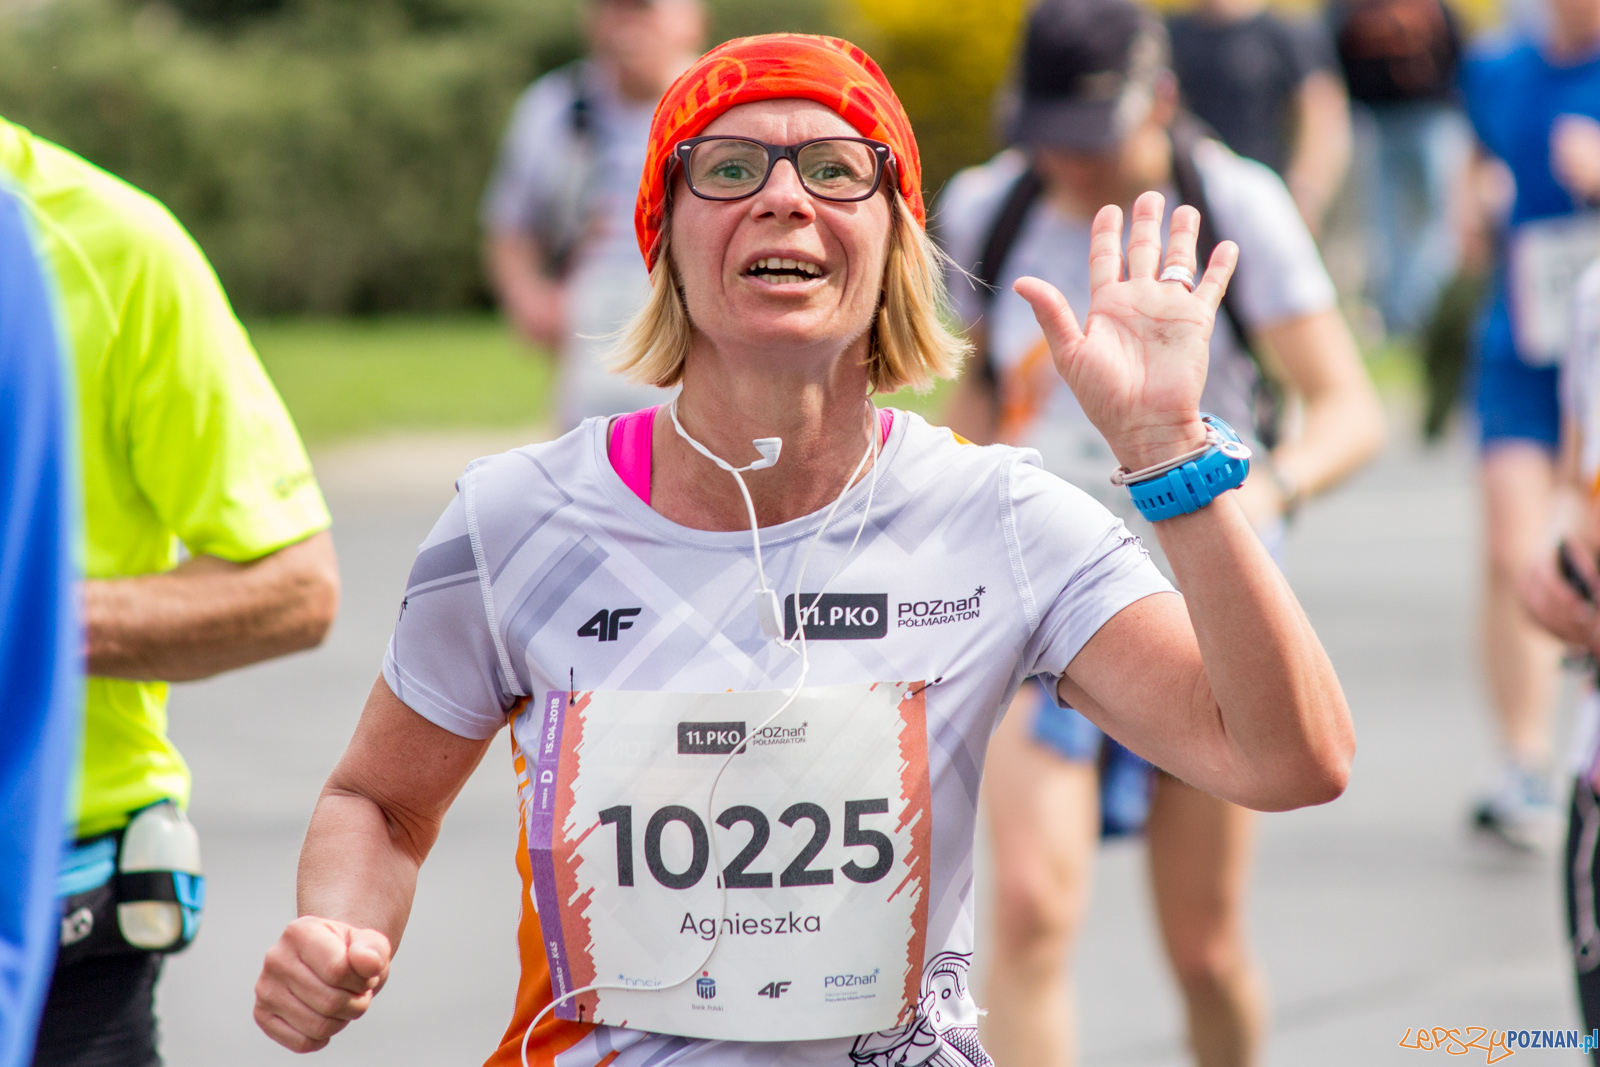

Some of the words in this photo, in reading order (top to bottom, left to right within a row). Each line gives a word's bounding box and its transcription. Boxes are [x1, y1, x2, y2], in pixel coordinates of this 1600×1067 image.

[577, 607, 642, 642] 4F
[829, 606, 879, 626] PKO
[897, 609, 981, 628] PÓŁMARATON
[544, 697, 560, 755] 15.04.2018
[685, 730, 704, 745] 11.
[706, 730, 741, 745] PKO
[752, 737, 806, 746] PÓŁMARATON
[540, 769, 554, 784] D
[598, 798, 894, 890] 10225
[680, 911, 821, 941] Agnieszka
[758, 981, 792, 998] 4F
